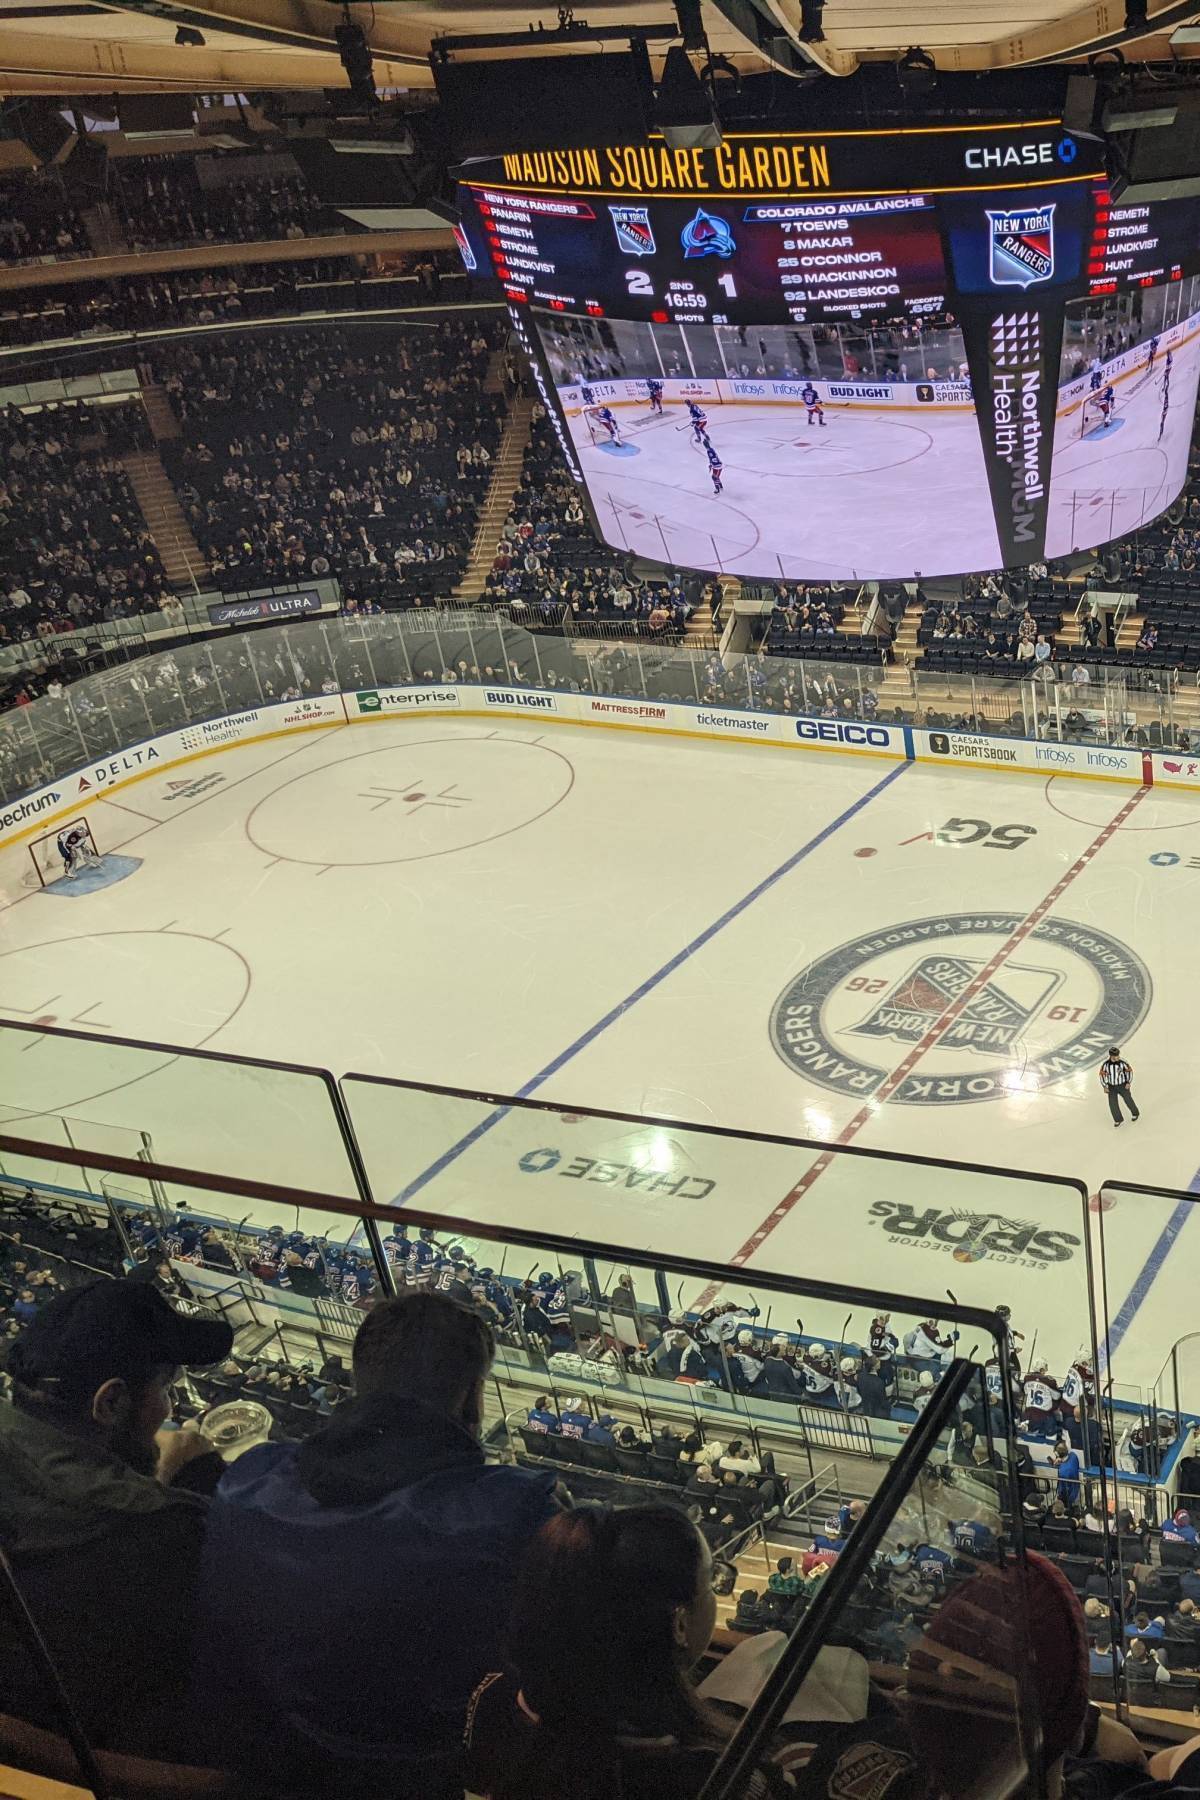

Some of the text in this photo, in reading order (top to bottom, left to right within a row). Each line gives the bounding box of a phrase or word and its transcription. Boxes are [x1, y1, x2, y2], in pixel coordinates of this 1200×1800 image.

[504, 141, 830, 189] MADISON SQUARE GARDEN
[965, 143, 1054, 169] CHASE
[484, 192, 578, 214] NEW YORK RANGERS
[757, 198, 925, 218] COLORADO AVALANCHE
[490, 207, 531, 223] PANARIN
[993, 213, 1050, 233] NEW YORK
[1109, 207, 1150, 221] NEMETH
[495, 223, 534, 239] NEMETH
[781, 219, 848, 232] 7 TOEWS
[1108, 224, 1148, 238] STROME
[621, 222, 653, 251] RANGERS
[784, 237, 853, 250] 8 MAKAR
[500, 240, 539, 255] STROME
[1002, 236, 1050, 275] RANGERS
[1106, 238, 1158, 255] LUNDKVIST
[505, 255, 556, 274] LUNDKVIST
[777, 252, 882, 267] 25 O'CONNOR
[1105, 259, 1134, 272] HUNT
[510, 272, 534, 285] HUNT
[625, 271, 654, 295] 2
[718, 273, 737, 298] 1
[781, 268, 897, 285] 29 MACKINNON
[669, 282, 694, 291] 2ND
[784, 284, 900, 301] 92 LANDESKOG
[664, 293, 708, 308] 16:59
[823, 304, 859, 312] BLOCKED
[904, 296, 944, 305] FACEOFFS
[909, 302, 943, 314] .667
[674, 314, 704, 322] SHOTS
[712, 315, 728, 324] 21
[794, 313, 805, 322] 6
[1100, 359, 1126, 379] DELTA
[734, 382, 804, 395] Infosys Infosys
[829, 386, 891, 399] BUD LIGHT
[993, 374, 1019, 457] Health
[1022, 370, 1044, 502] Northwell
[219, 597, 312, 622] Michelob ULTRA
[365, 691, 457, 708] enterprise
[487, 692, 553, 708] BUD LIGHT
[202, 711, 259, 734] Northwell
[697, 713, 769, 731] ticketmaster
[205, 728, 242, 745] Health
[796, 720, 890, 747] GEICO
[950, 736, 989, 746] CAESARS
[951, 744, 1017, 761] SPORTSBOOK
[1035, 747, 1127, 769] Infosys Infosys
[96, 746, 160, 783] DELTA
[939, 817, 1038, 850] 5G
[854, 921, 952, 957] GARDEN
[1068, 931, 1133, 982] MADISON
[845, 976, 889, 995] 26
[1048, 1005, 1088, 1024] 19
[875, 1009, 1018, 1045] NEW YORK
[785, 1003, 883, 1090] RANGERS
[1034, 1030, 1115, 1079] NEW
[560, 1156, 717, 1200] CHASE
[887, 1234, 953, 1255] SECTOR
